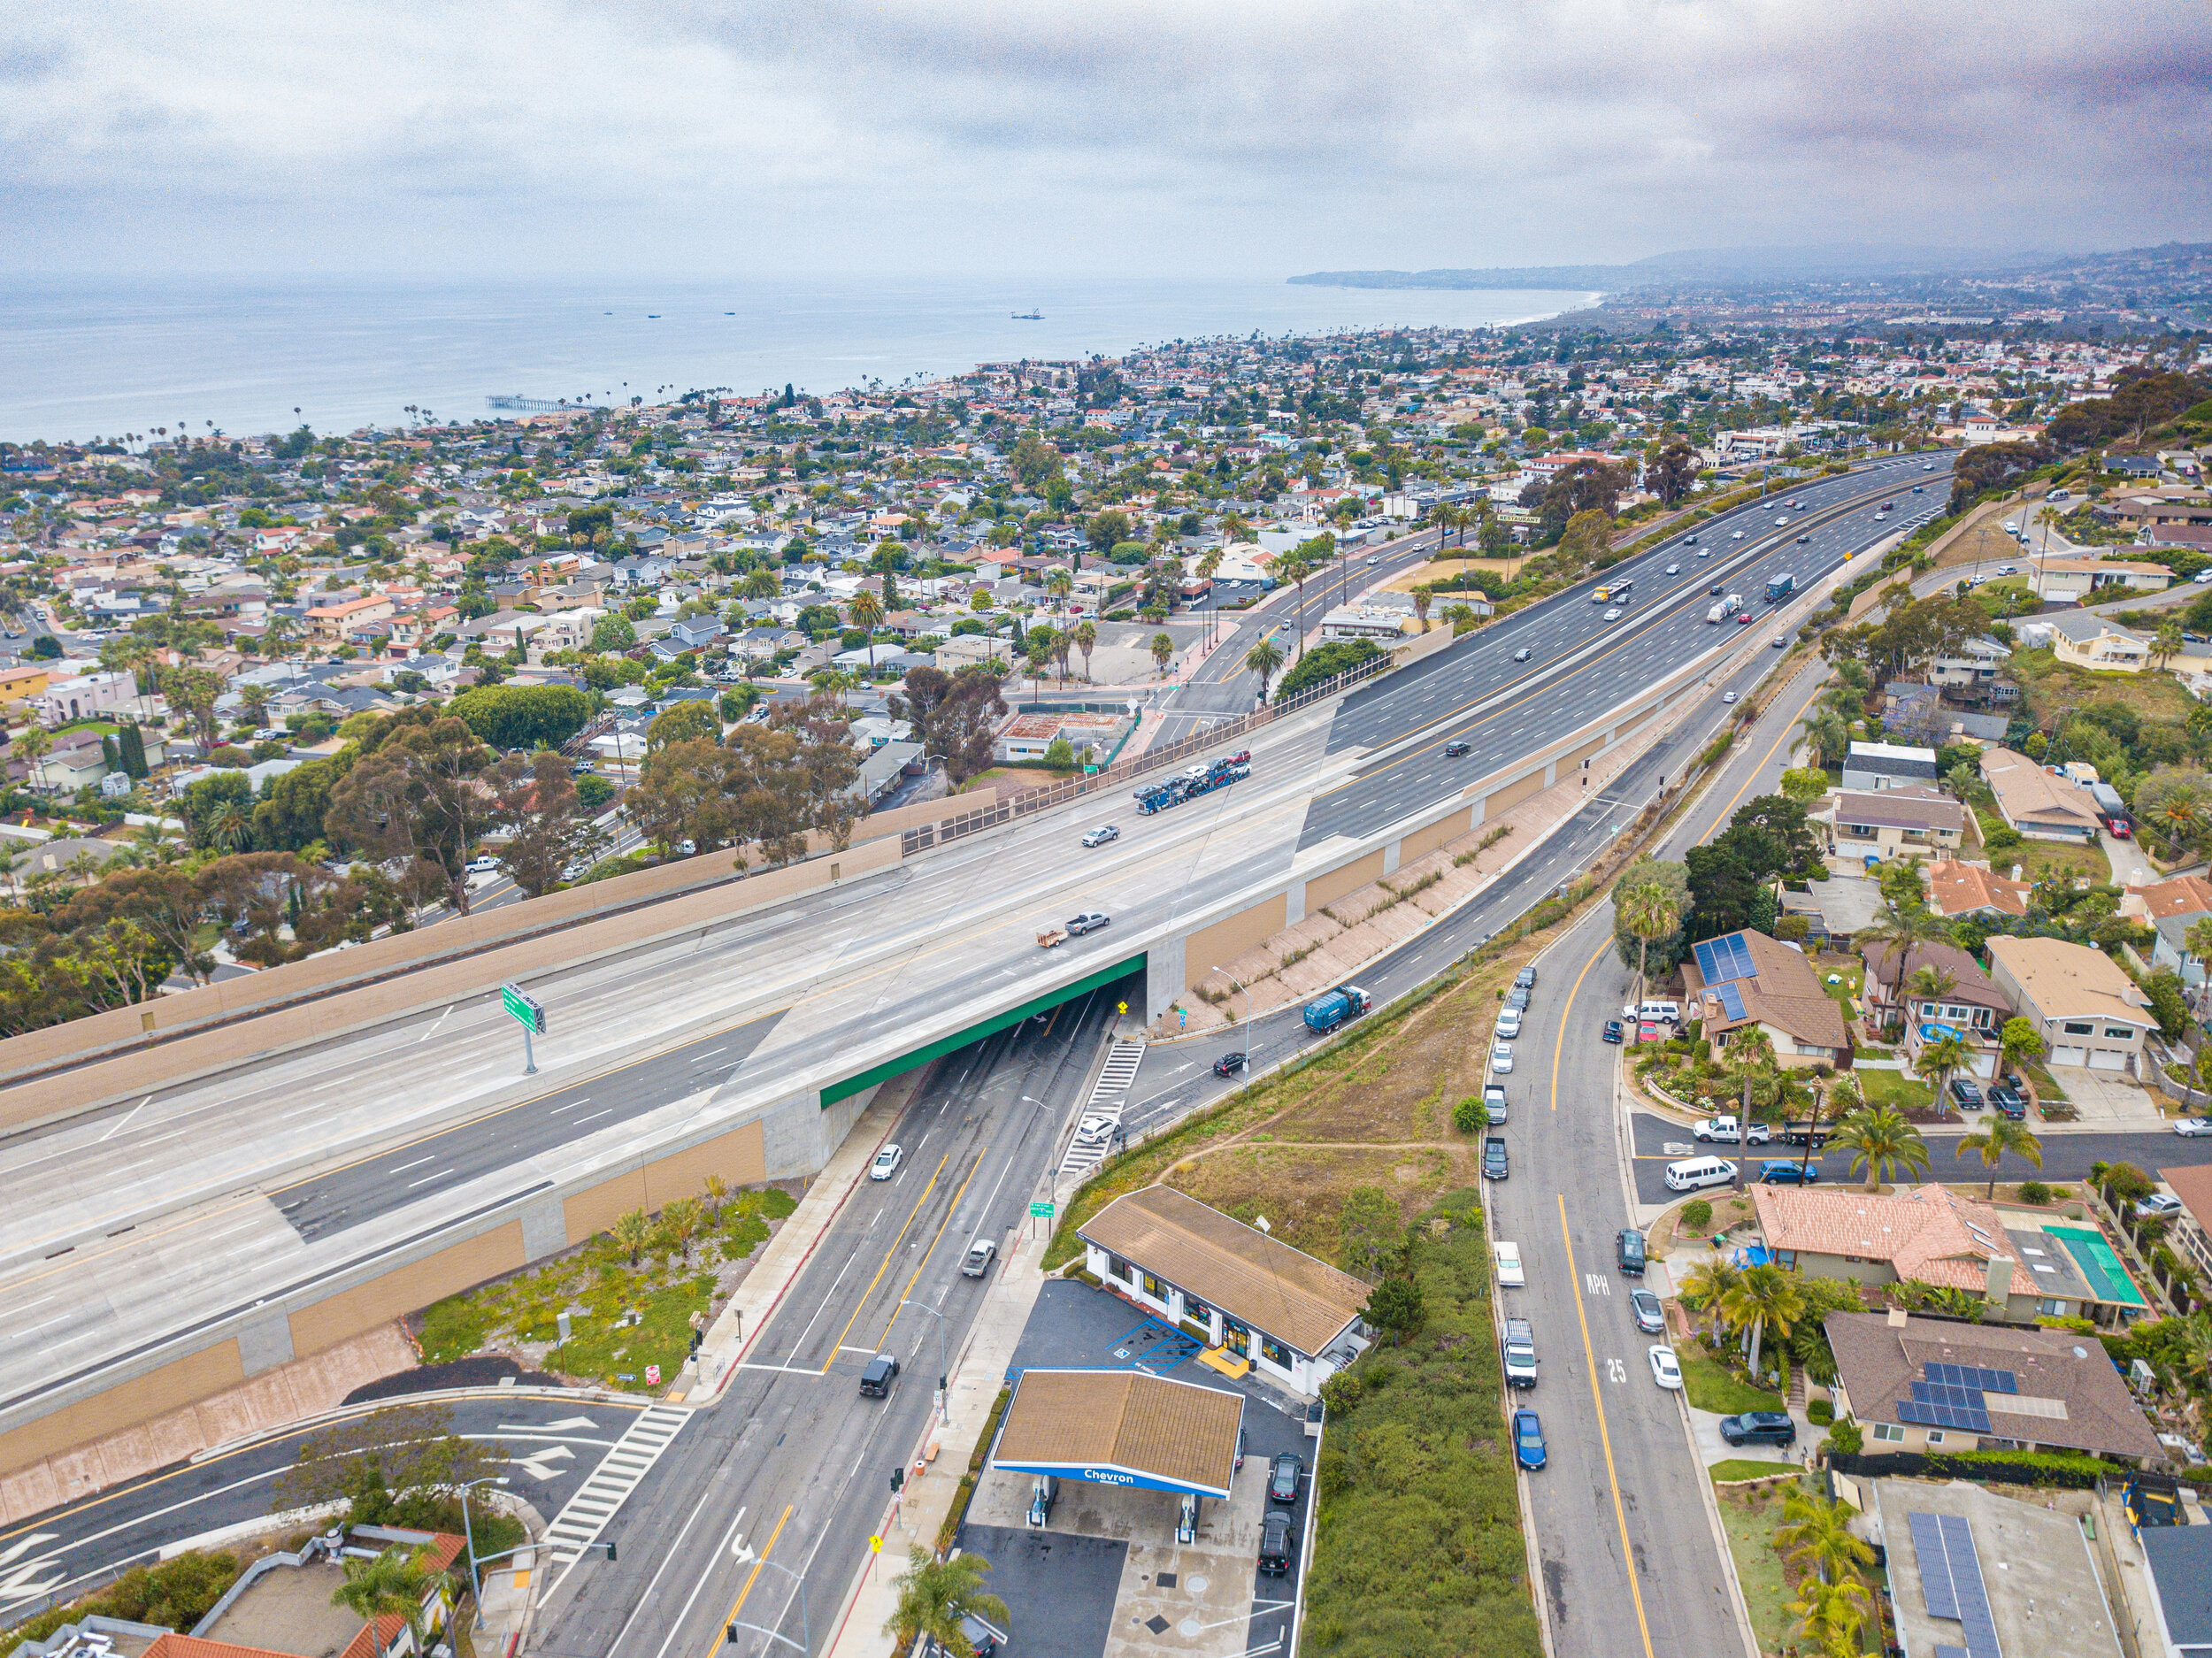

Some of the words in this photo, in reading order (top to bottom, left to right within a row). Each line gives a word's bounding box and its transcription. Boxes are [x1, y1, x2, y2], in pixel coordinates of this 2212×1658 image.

[1586, 1273, 1610, 1296] MPH
[1607, 1358, 1626, 1383] 25
[1084, 1469, 1133, 1484] Chevron
